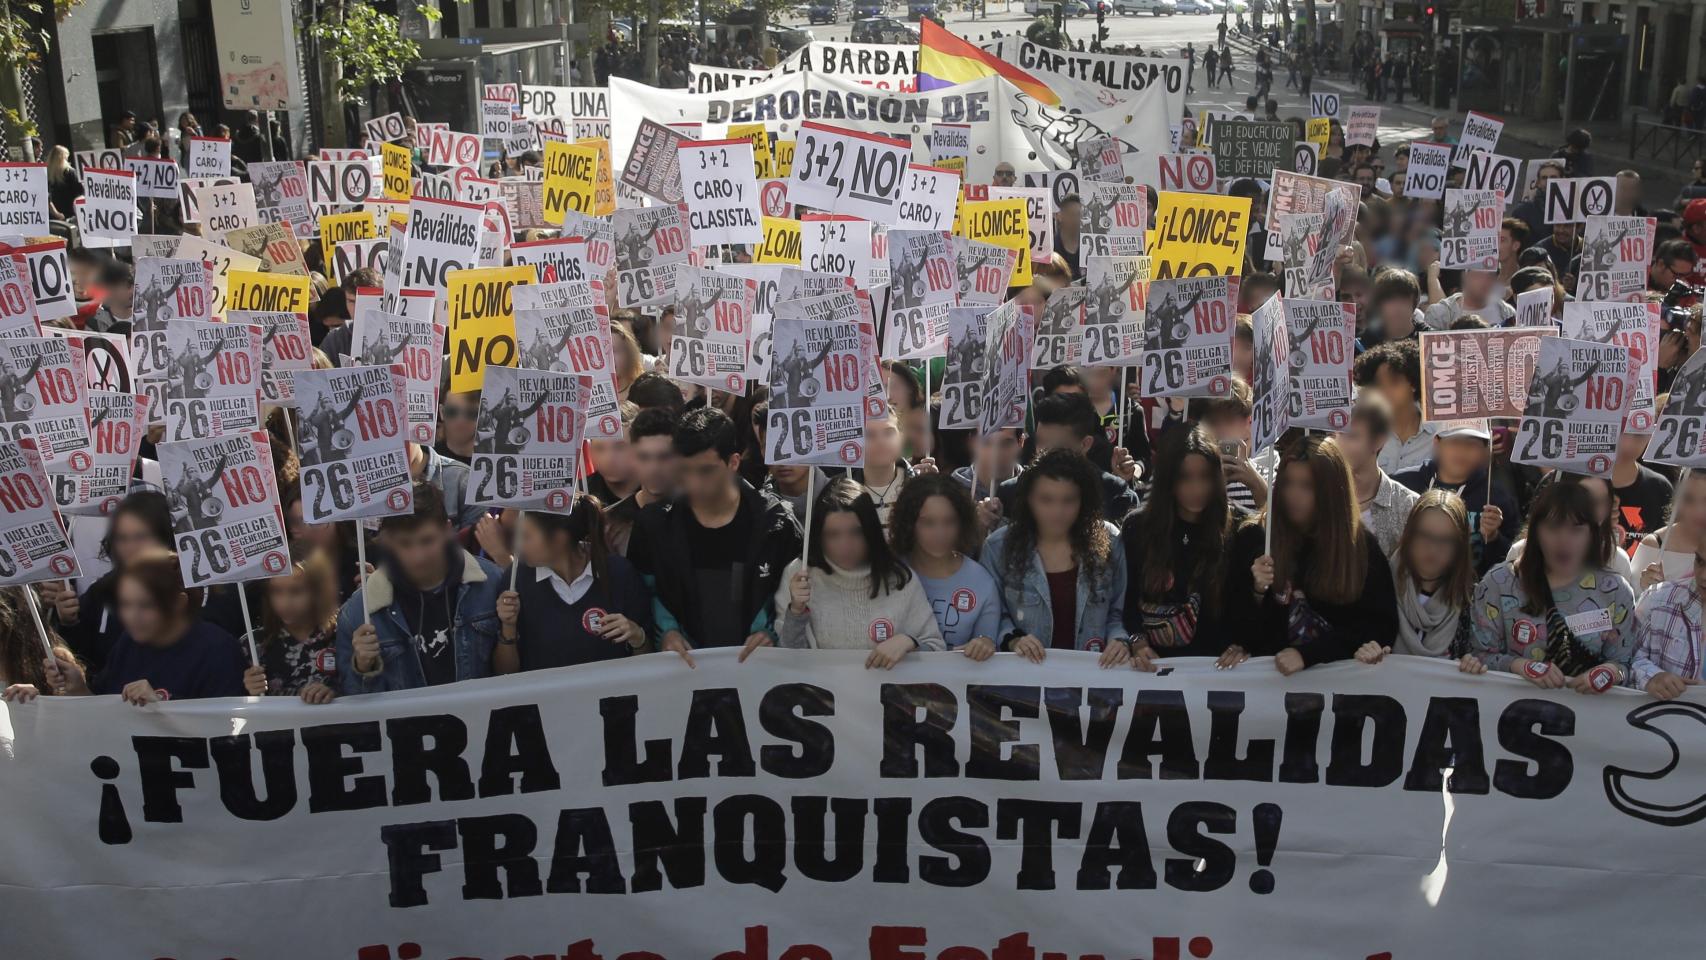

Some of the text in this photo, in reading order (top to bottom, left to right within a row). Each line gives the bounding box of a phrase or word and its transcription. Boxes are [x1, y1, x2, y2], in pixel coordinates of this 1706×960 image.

[521, 90, 608, 117] POR UNA
[707, 89, 990, 124] DEROGACIÓN DE
[1311, 94, 1338, 116] NO
[368, 115, 404, 139] NO
[485, 121, 511, 134] ¡NO!
[933, 131, 969, 149] Reválidas,
[1220, 125, 1231, 138] LA
[1465, 119, 1498, 143] Reválidas,
[195, 156, 216, 168] CARO
[430, 133, 481, 165] NO
[626, 123, 656, 183] LOMCE
[1220, 142, 1231, 157] NO
[1235, 141, 1248, 158] SE
[1411, 147, 1447, 168] Reválidas,
[546, 151, 593, 187] ¡LOMCE,
[850, 145, 907, 200] NO!
[1159, 154, 1215, 192] NO
[1217, 159, 1230, 172] SE
[1465, 153, 1516, 200] NO
[87, 176, 134, 202] Reválidas,
[312, 163, 371, 204] NO
[384, 174, 409, 195] NO!
[694, 178, 743, 202] CARO y
[1406, 174, 1444, 194] ¡NO!
[545, 187, 591, 213] NO!
[1548, 179, 1613, 222] NO
[87, 211, 134, 235] ¡NO!
[209, 214, 239, 231] CARO
[412, 207, 478, 249] Reválidas,
[690, 207, 757, 231] CLASISTA.
[899, 201, 942, 229] CARO y
[969, 209, 1024, 243] ¡LOMCE,
[1115, 201, 1139, 228] NO
[1474, 207, 1497, 230] NO
[654, 226, 685, 256] NO
[1158, 206, 1241, 256] ¡LOMCE,
[266, 240, 297, 266] NO
[1442, 239, 1468, 267] 26
[1619, 239, 1646, 263] NO
[810, 253, 856, 277] CARO y
[926, 257, 952, 293] NO
[620, 269, 654, 305] 26
[701, 275, 743, 290] REVÁLIDAS
[975, 266, 1002, 295] NO
[1286, 269, 1307, 299] 26
[1580, 271, 1610, 303] 26
[176, 285, 205, 318] NO
[453, 280, 529, 331] ¡LOMC
[1292, 304, 1341, 320] REVÁLIDAS
[544, 306, 595, 331] REVÁLIDAS
[713, 300, 743, 334] NO
[1193, 300, 1227, 336] NO
[197, 322, 247, 342] REVÁLIDAS
[804, 323, 857, 342] REVÁLIDAS
[893, 309, 926, 357] 26
[1085, 325, 1120, 364] 26
[10, 337, 67, 359] REVÁLIDAS
[273, 333, 305, 362] NO
[567, 335, 607, 374] NO
[672, 336, 706, 378] 26
[706, 342, 739, 356] HUELGA
[806, 338, 859, 354] FRANUISTAS
[1035, 335, 1065, 367] 26
[1186, 346, 1222, 361] HUELGA
[1310, 331, 1345, 366] NO
[1571, 346, 1626, 362] REVÁLIDAS
[216, 351, 252, 388] NO
[402, 347, 432, 382] NO
[824, 353, 859, 393] NO
[1145, 349, 1186, 395] 26
[1195, 357, 1224, 369] GENERAL
[1467, 354, 1478, 397] IMPUESTA
[1572, 361, 1627, 375] FRANUISTAS
[35, 367, 78, 406] NO
[329, 366, 389, 393] REVÁLIDAS
[519, 374, 576, 391] REVÁLIDAS
[1303, 378, 1340, 390] HUELGA
[1431, 339, 1457, 416] LOMCE
[209, 398, 247, 412] HUELGA
[333, 382, 393, 405] FRANUISTAS
[520, 391, 577, 404] FRANUISTAS
[945, 382, 982, 425] 26
[1313, 388, 1341, 399] GENERAL
[1585, 375, 1624, 412] NO
[34, 417, 76, 435] HUELGA
[170, 398, 209, 441] 26
[354, 398, 399, 442] NO
[536, 405, 575, 443] NO
[814, 405, 853, 422] HUELGA
[825, 419, 855, 431] GENERAL
[48, 429, 79, 443] GENERAL
[96, 420, 131, 455] NO
[770, 408, 814, 462] 26
[816, 422, 827, 452] octubre
[1519, 418, 1565, 461] 26
[1567, 422, 1610, 435] HUELGA
[1577, 434, 1610, 443] GENERAL
[1653, 416, 1702, 461] 26
[192, 438, 251, 463] REVÁLIDAS
[198, 450, 257, 474] FRANUISTAS
[351, 452, 396, 475] HUELGA
[522, 457, 564, 470] HUELGA
[220, 464, 267, 509] NO
[365, 465, 400, 482] GENERAL
[474, 455, 518, 503] 26
[532, 469, 565, 479] GENERAL
[303, 462, 356, 521] 26
[4, 522, 49, 545] HUELGA
[224, 517, 269, 540] HUELGA
[239, 530, 273, 546] GENERAL
[21, 534, 56, 551] GENERAL
[179, 529, 232, 585] 26
[90, 668, 1576, 846] ¡FUERA LAS REVÁLIDAS
[381, 794, 1283, 908] FRANQUISTAS!
